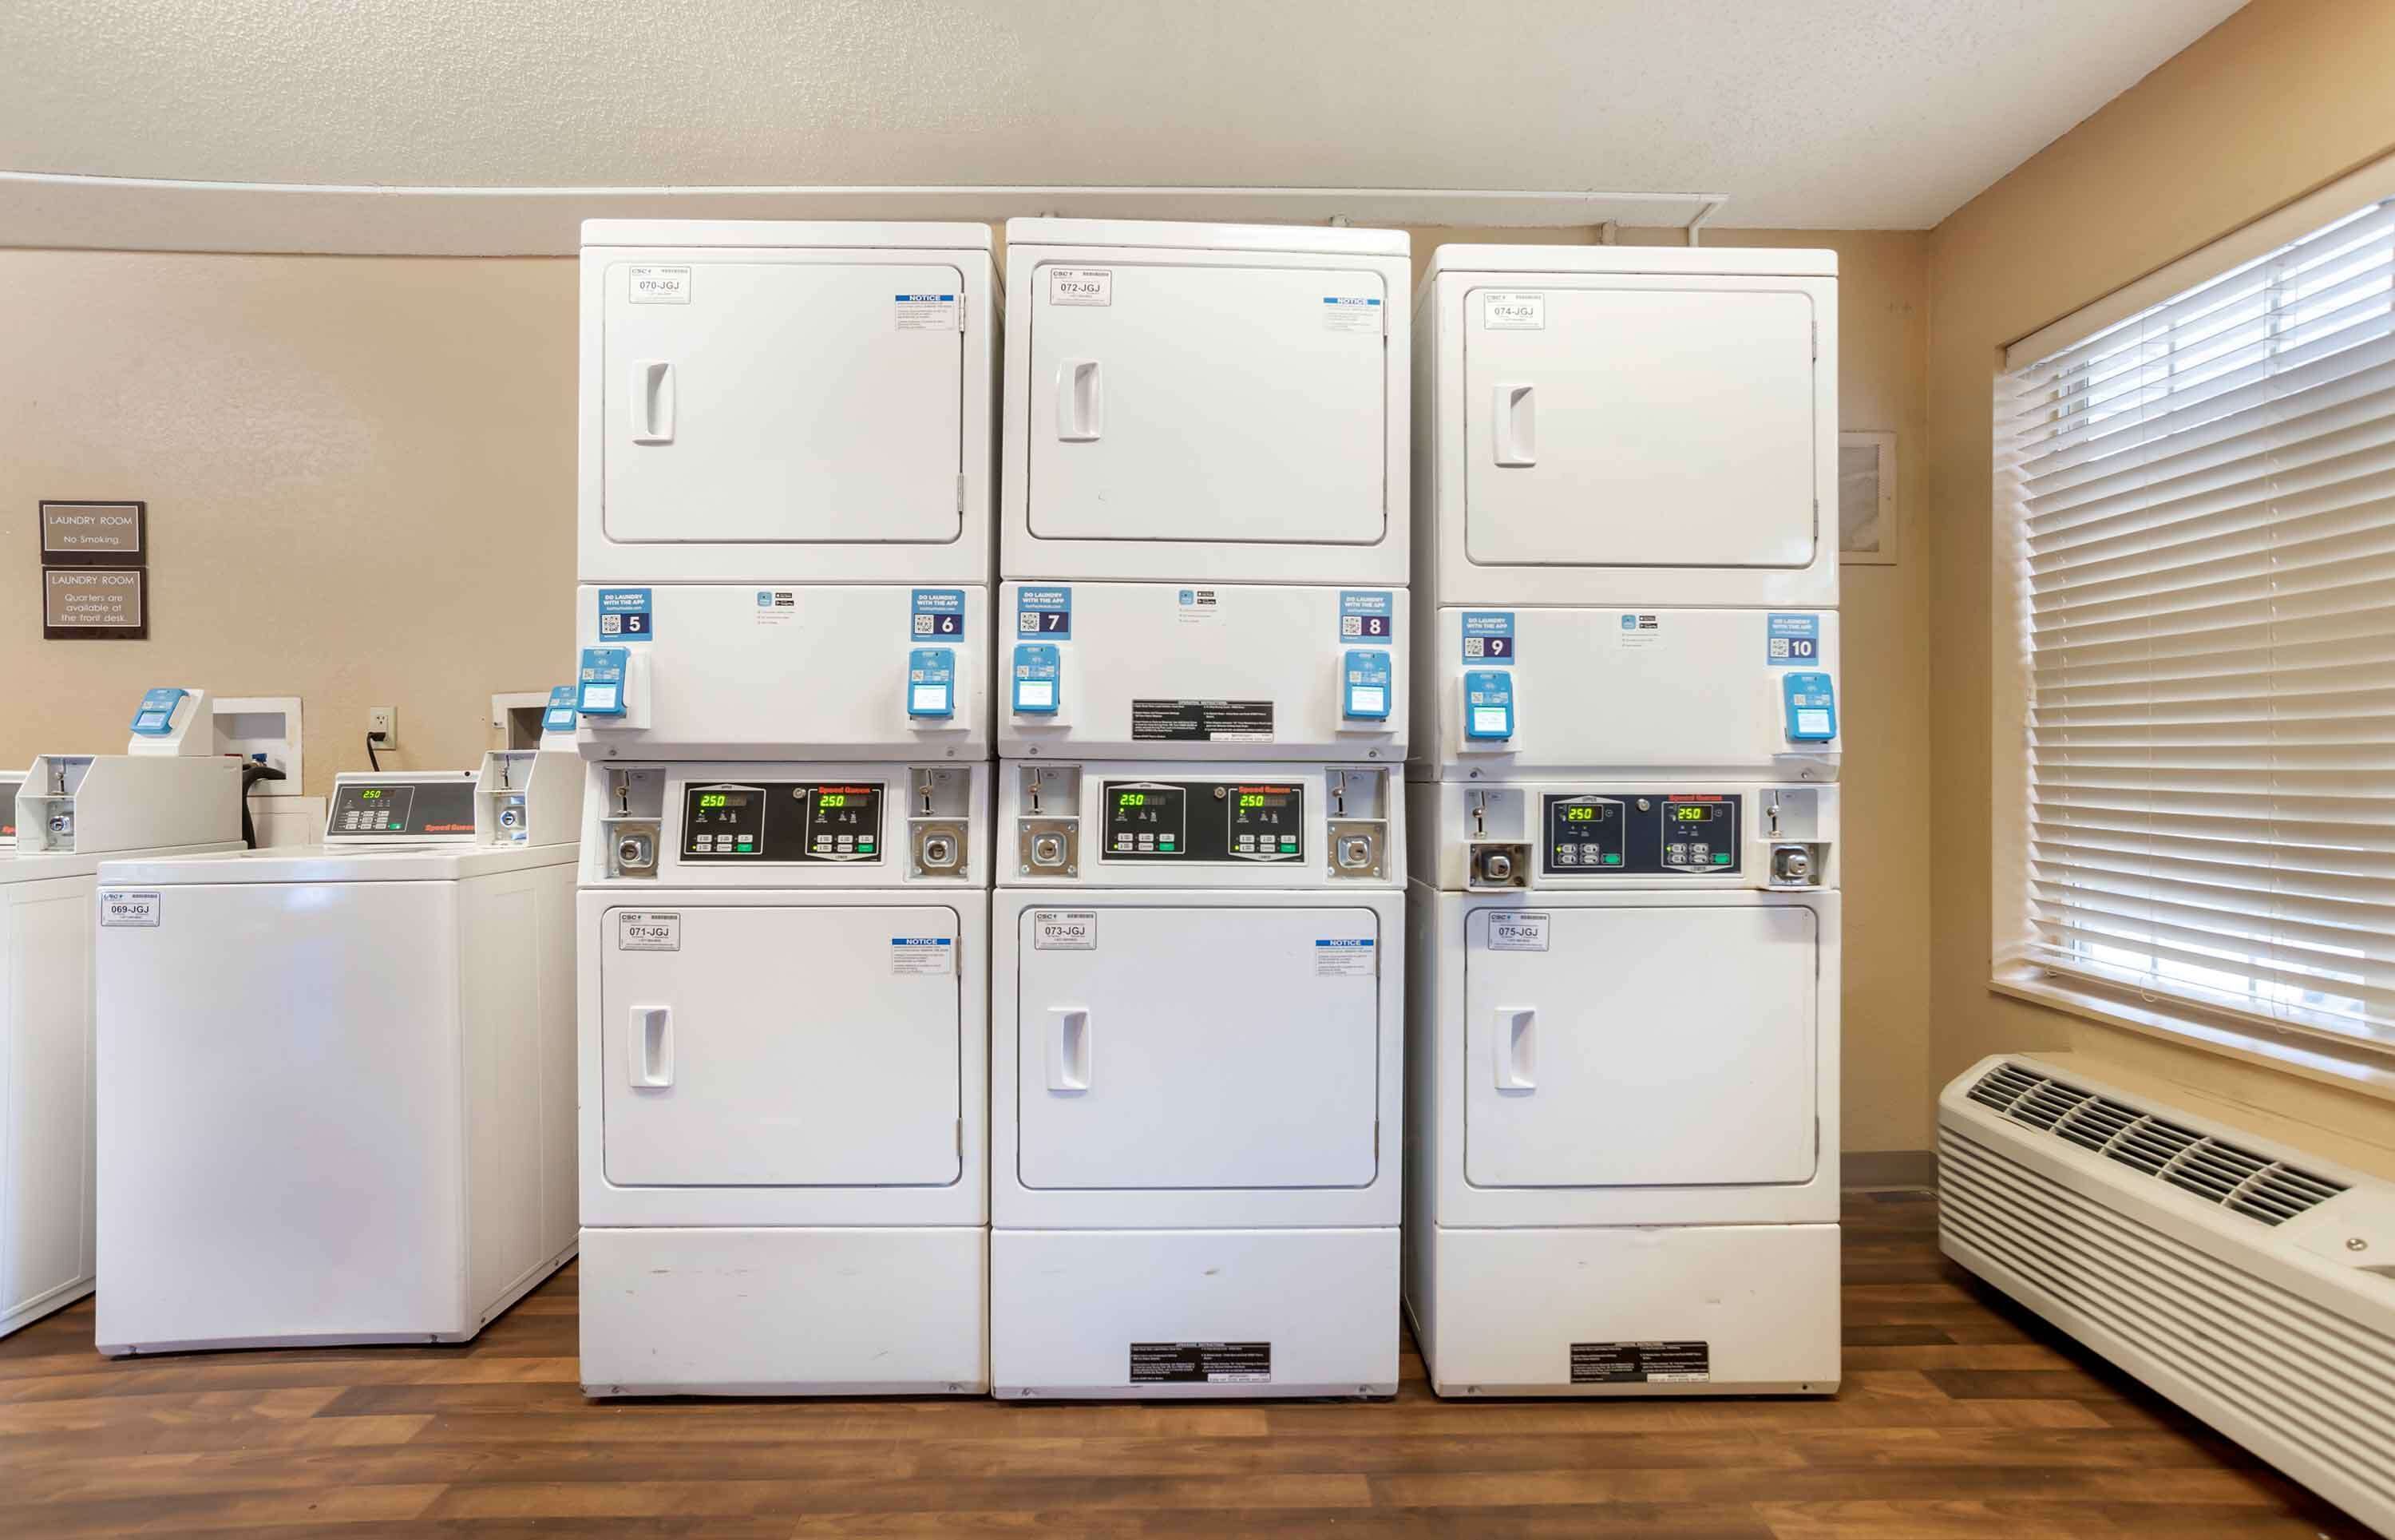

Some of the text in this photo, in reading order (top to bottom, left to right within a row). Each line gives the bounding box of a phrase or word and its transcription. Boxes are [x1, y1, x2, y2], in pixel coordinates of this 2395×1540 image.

[1061, 283, 1100, 292] 072-JGJ
[49, 517, 96, 525] LAUNDRY
[64, 593, 104, 602] Quarters
[629, 616, 640, 631] 5
[942, 616, 954, 632] 6
[1048, 615, 1060, 631] 7
[1370, 619, 1381, 634] 8
[1491, 639, 1503, 655] 9
[1792, 640, 1811, 656] 10
[820, 795, 845, 806] 2.50
[1120, 794, 1144, 806] 2.50
[1240, 795, 1265, 806] 2.50
[629, 927, 669, 936] 071-JGJ
[1045, 926, 1085, 935] 073-JGJ
[1498, 927, 1538, 936] 075-JGJ
